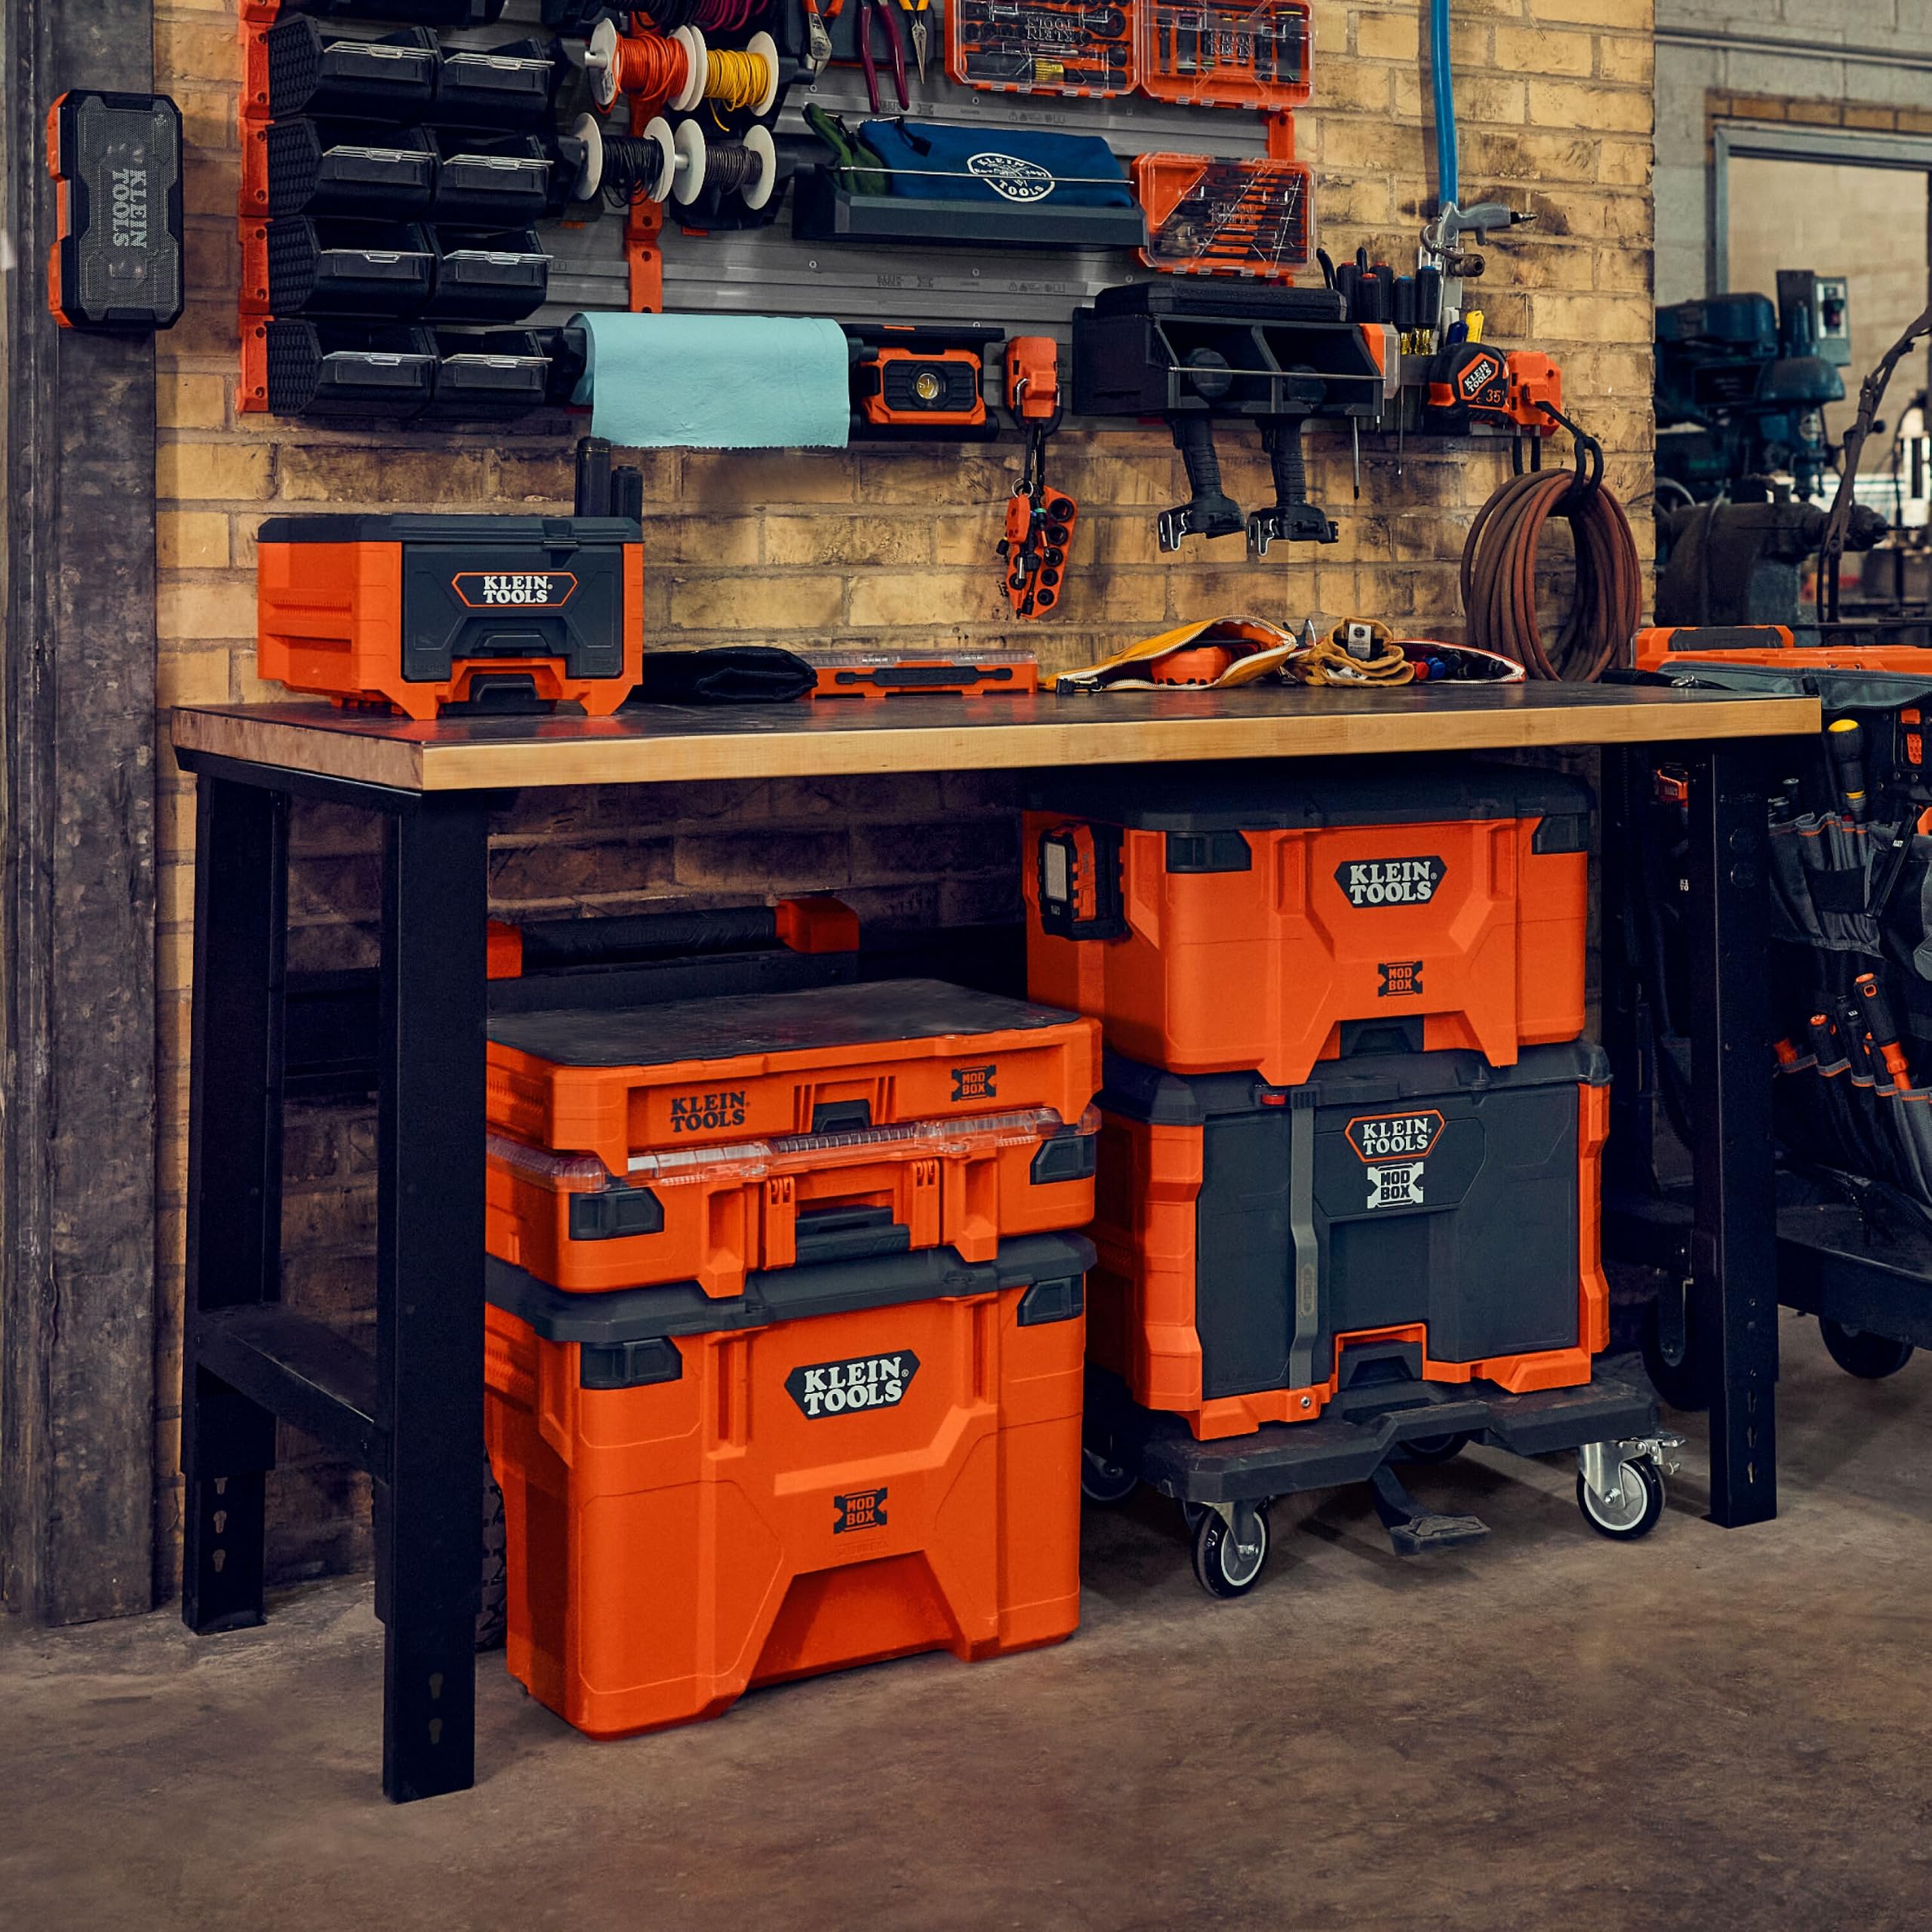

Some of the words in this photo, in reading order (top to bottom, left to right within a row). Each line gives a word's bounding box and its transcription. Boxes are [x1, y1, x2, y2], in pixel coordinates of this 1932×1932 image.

[1027, 16, 1075, 32] TOOLS
[1027, 27, 1075, 42] KLEIN
[977, 157, 1025, 167] KLEIN
[998, 180, 1044, 196] TOOLS
[112, 168, 130, 247] TOOLS
[130, 168, 147, 248] KLEIN
[1464, 361, 1490, 387] KLEIN
[1468, 368, 1492, 392] TOOLS
[483, 576, 549, 589] KLEIN
[483, 589, 548, 603] TOOLS
[1349, 861, 1431, 884] KLEIN
[1349, 881, 1432, 904] TOOLS
[1388, 968, 1412, 979] MOD
[1388, 979, 1412, 991] BOX
[962, 1072, 986, 1084] MOD
[962, 1083, 985, 1095] BOX
[672, 1091, 746, 1115] KLEIN
[670, 1109, 746, 1132] TOOLS
[1363, 1118, 1429, 1140] KLEIN
[1363, 1134, 1429, 1155] TOOLS
[1380, 1170, 1411, 1186] MOD
[1380, 1184, 1411, 1200] BOX
[804, 1356, 901, 1393] KLEIN
[804, 1380, 903, 1415] TOOLS
[846, 1496, 875, 1512] MOD
[846, 1509, 875, 1525] BOX
